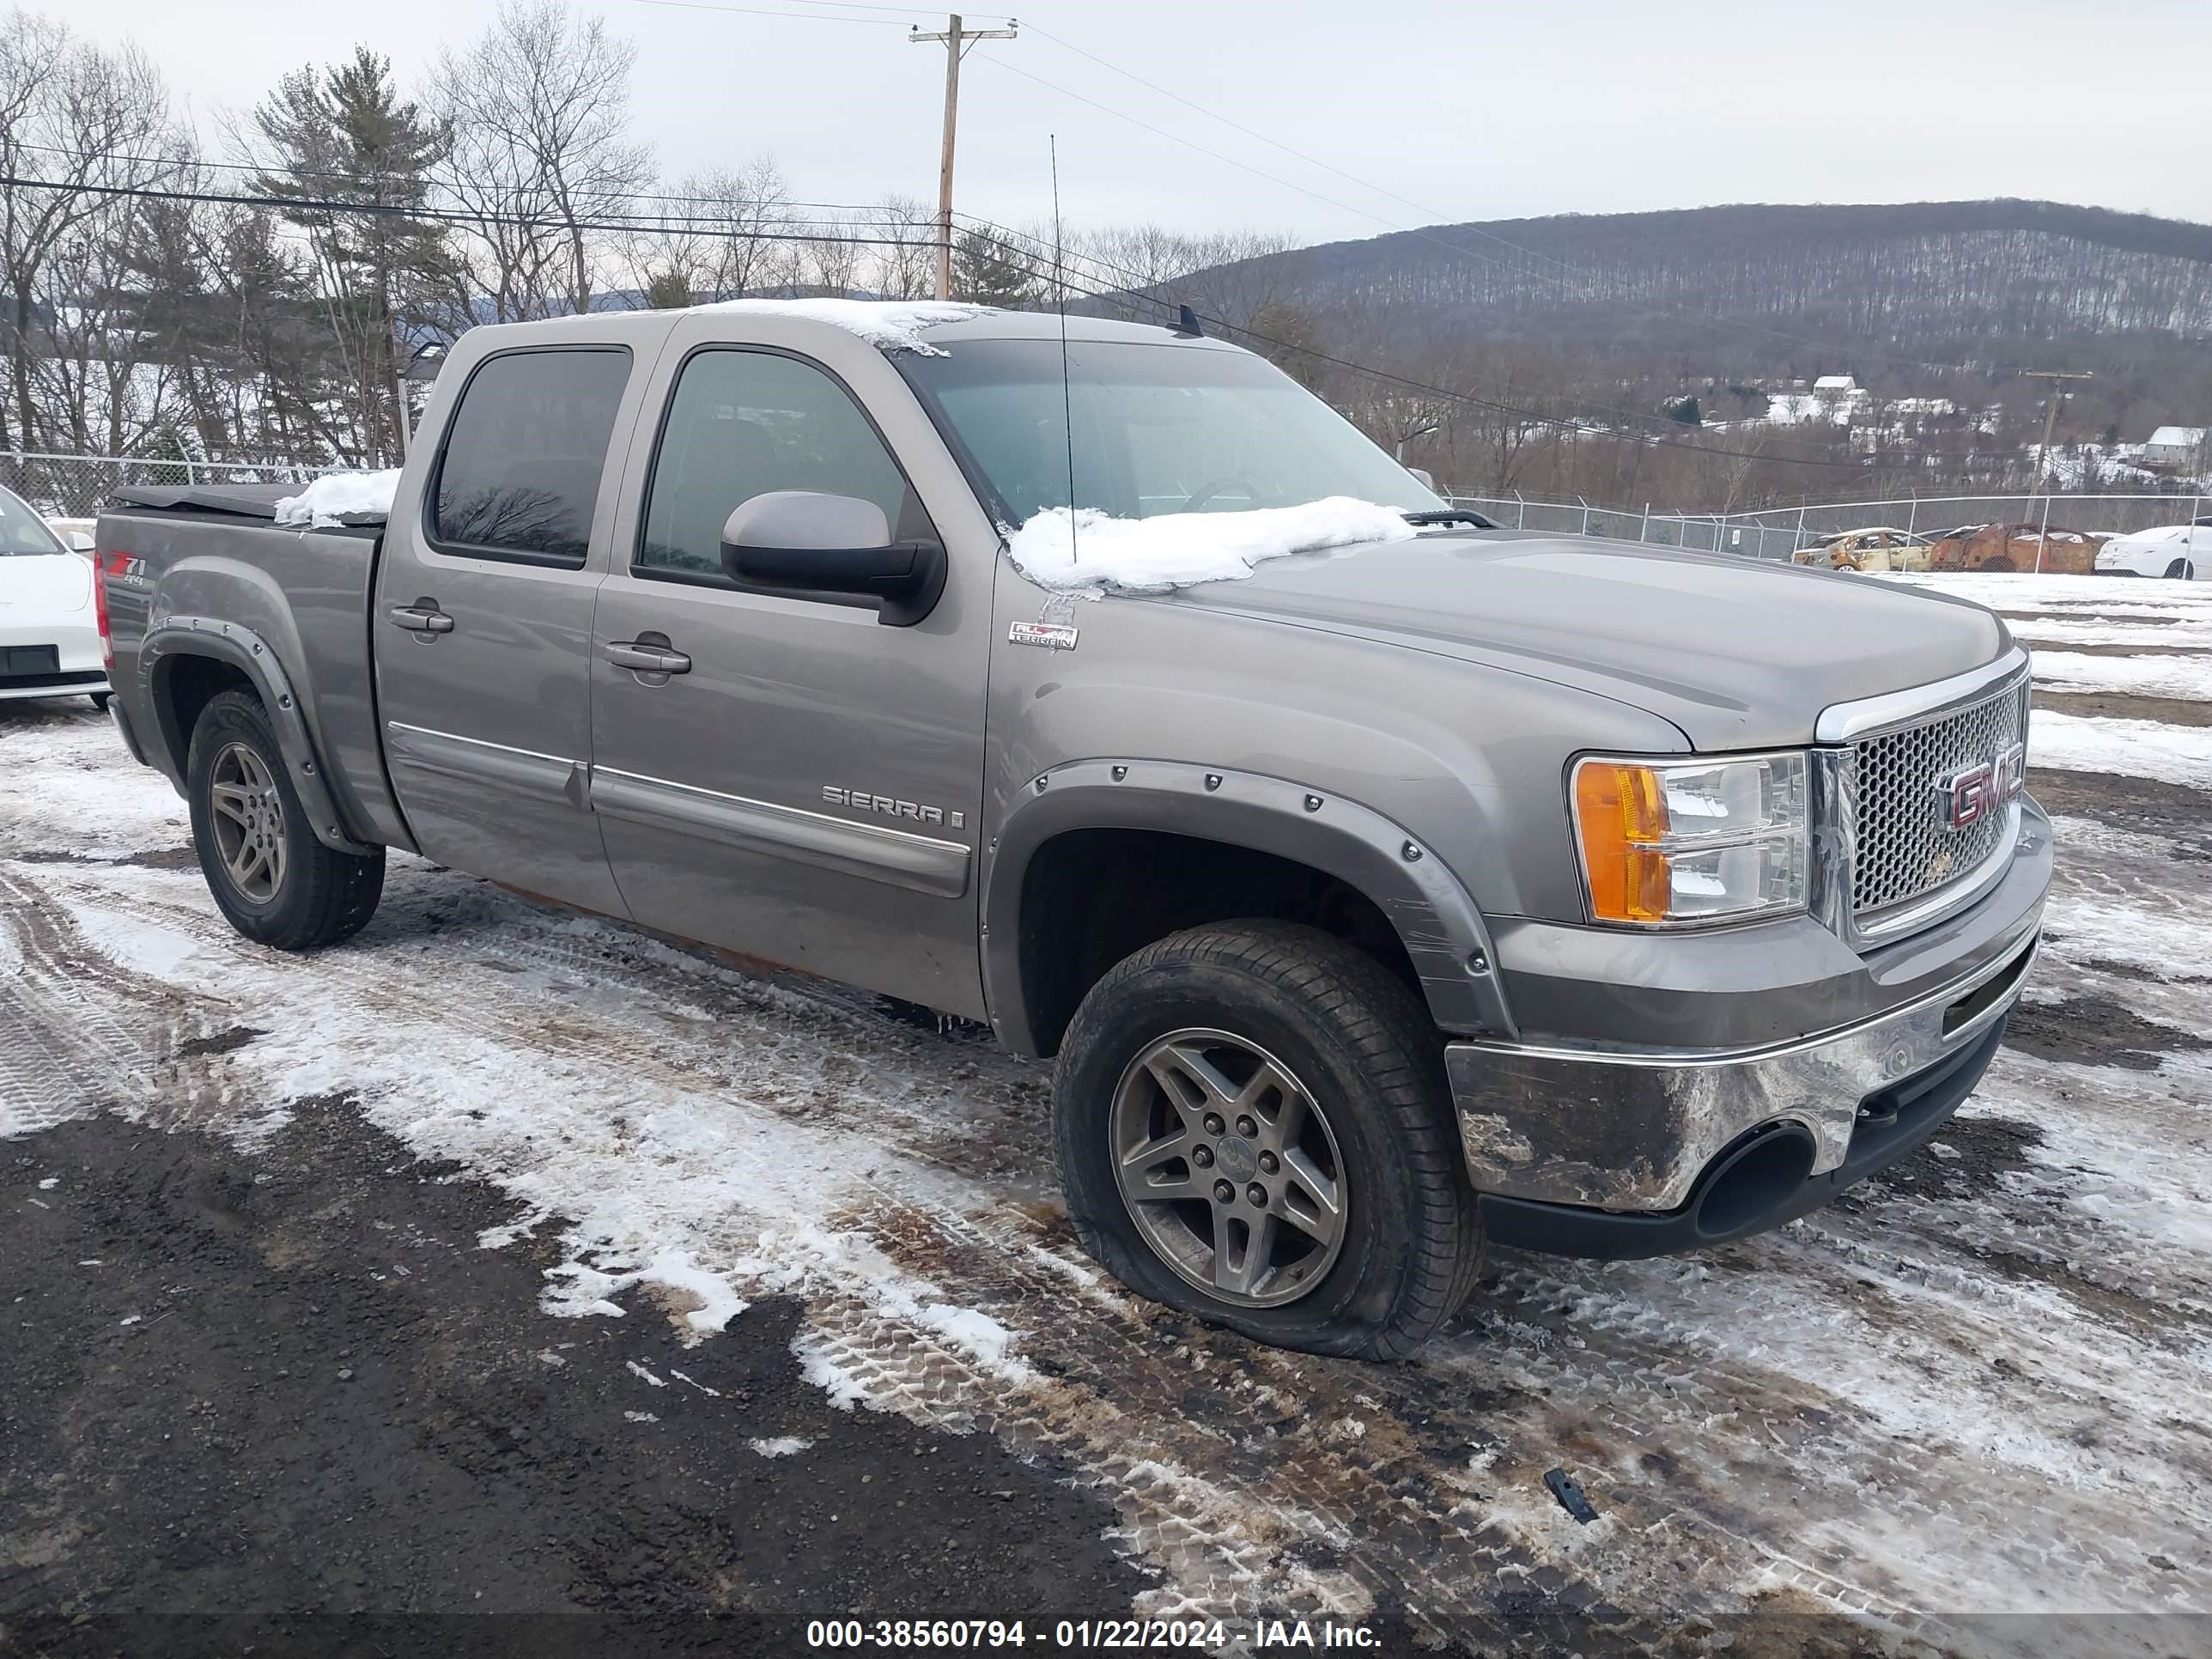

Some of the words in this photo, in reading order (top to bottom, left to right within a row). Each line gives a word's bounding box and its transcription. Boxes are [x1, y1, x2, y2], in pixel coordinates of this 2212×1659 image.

[1013, 634, 1072, 647] TERRAIN
[1016, 624, 1042, 635] ALL
[1953, 741, 2022, 830] GMC
[822, 786, 945, 825] SIERRA
